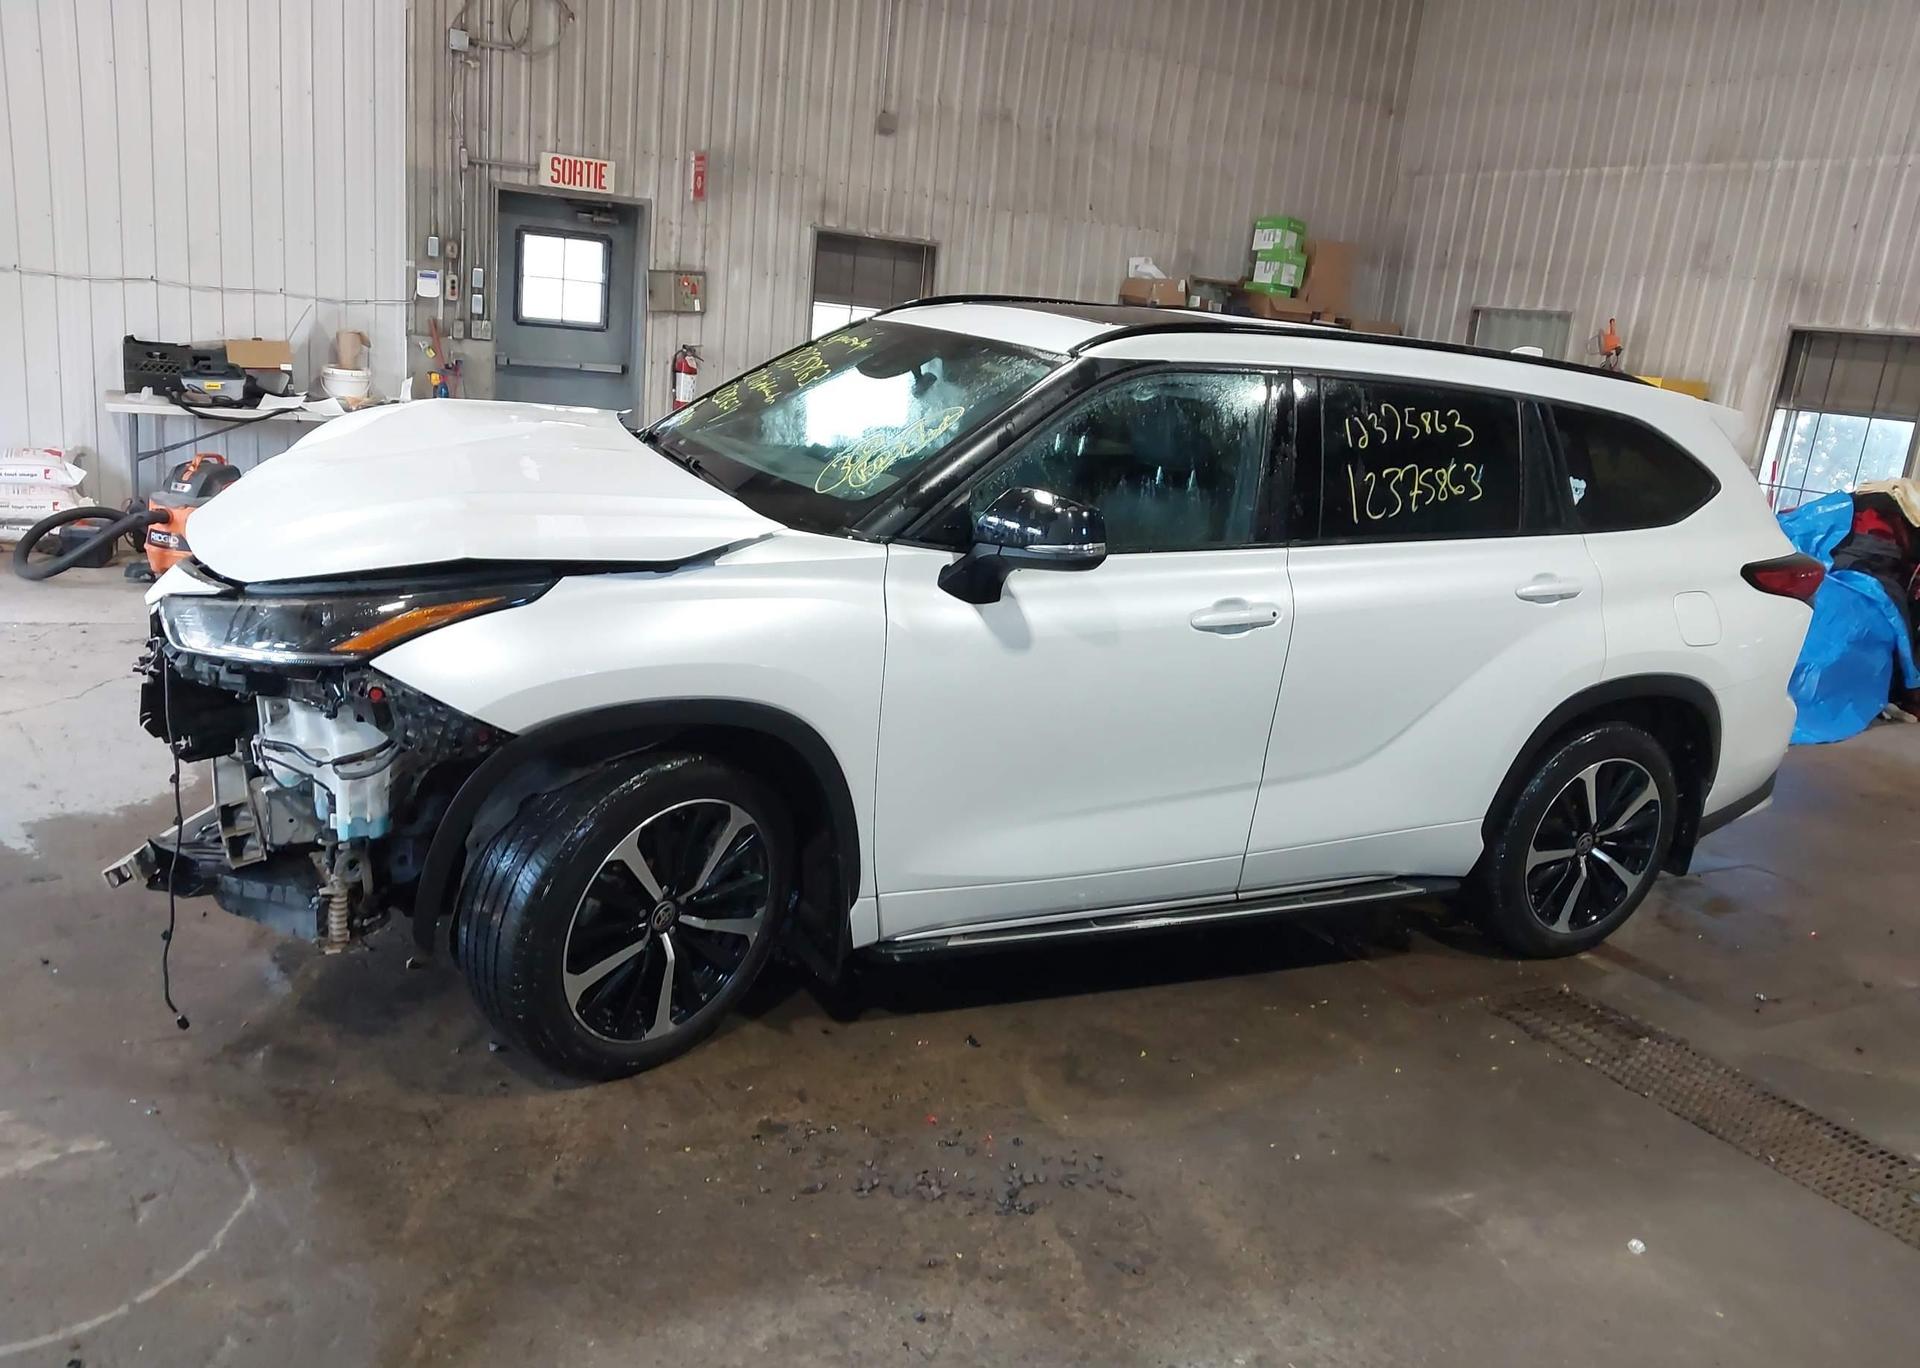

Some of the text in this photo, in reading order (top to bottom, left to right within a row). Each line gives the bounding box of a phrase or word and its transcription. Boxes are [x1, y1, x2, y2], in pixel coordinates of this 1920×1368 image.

[550, 156, 608, 190] SORTIE
[1345, 403, 1474, 448] 12375863
[1347, 458, 1484, 524] 12375863
